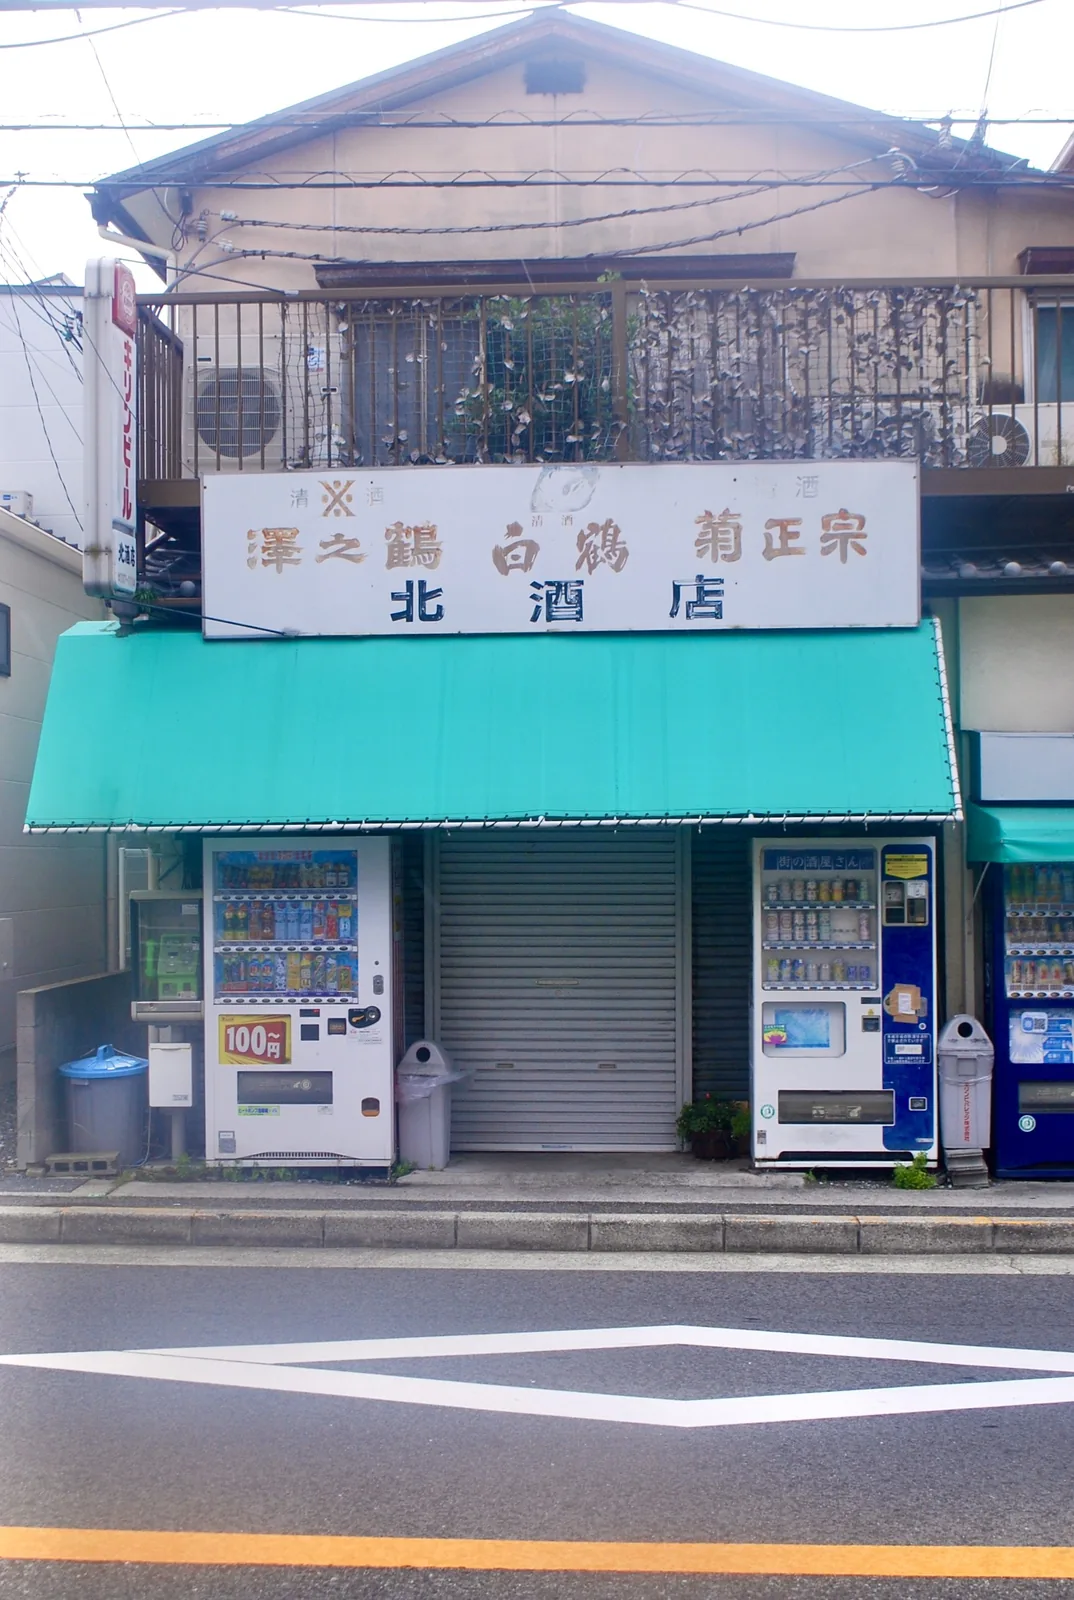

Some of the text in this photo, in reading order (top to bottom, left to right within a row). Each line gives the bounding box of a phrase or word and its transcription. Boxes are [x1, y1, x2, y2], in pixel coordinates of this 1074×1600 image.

[121, 339, 133, 521] キリンビール
[492, 518, 630, 576] 白鶴
[694, 507, 868, 564] 菊正宗
[390, 574, 725, 623] 北酒店
[778, 855, 859, 869] 街の酒屋さん
